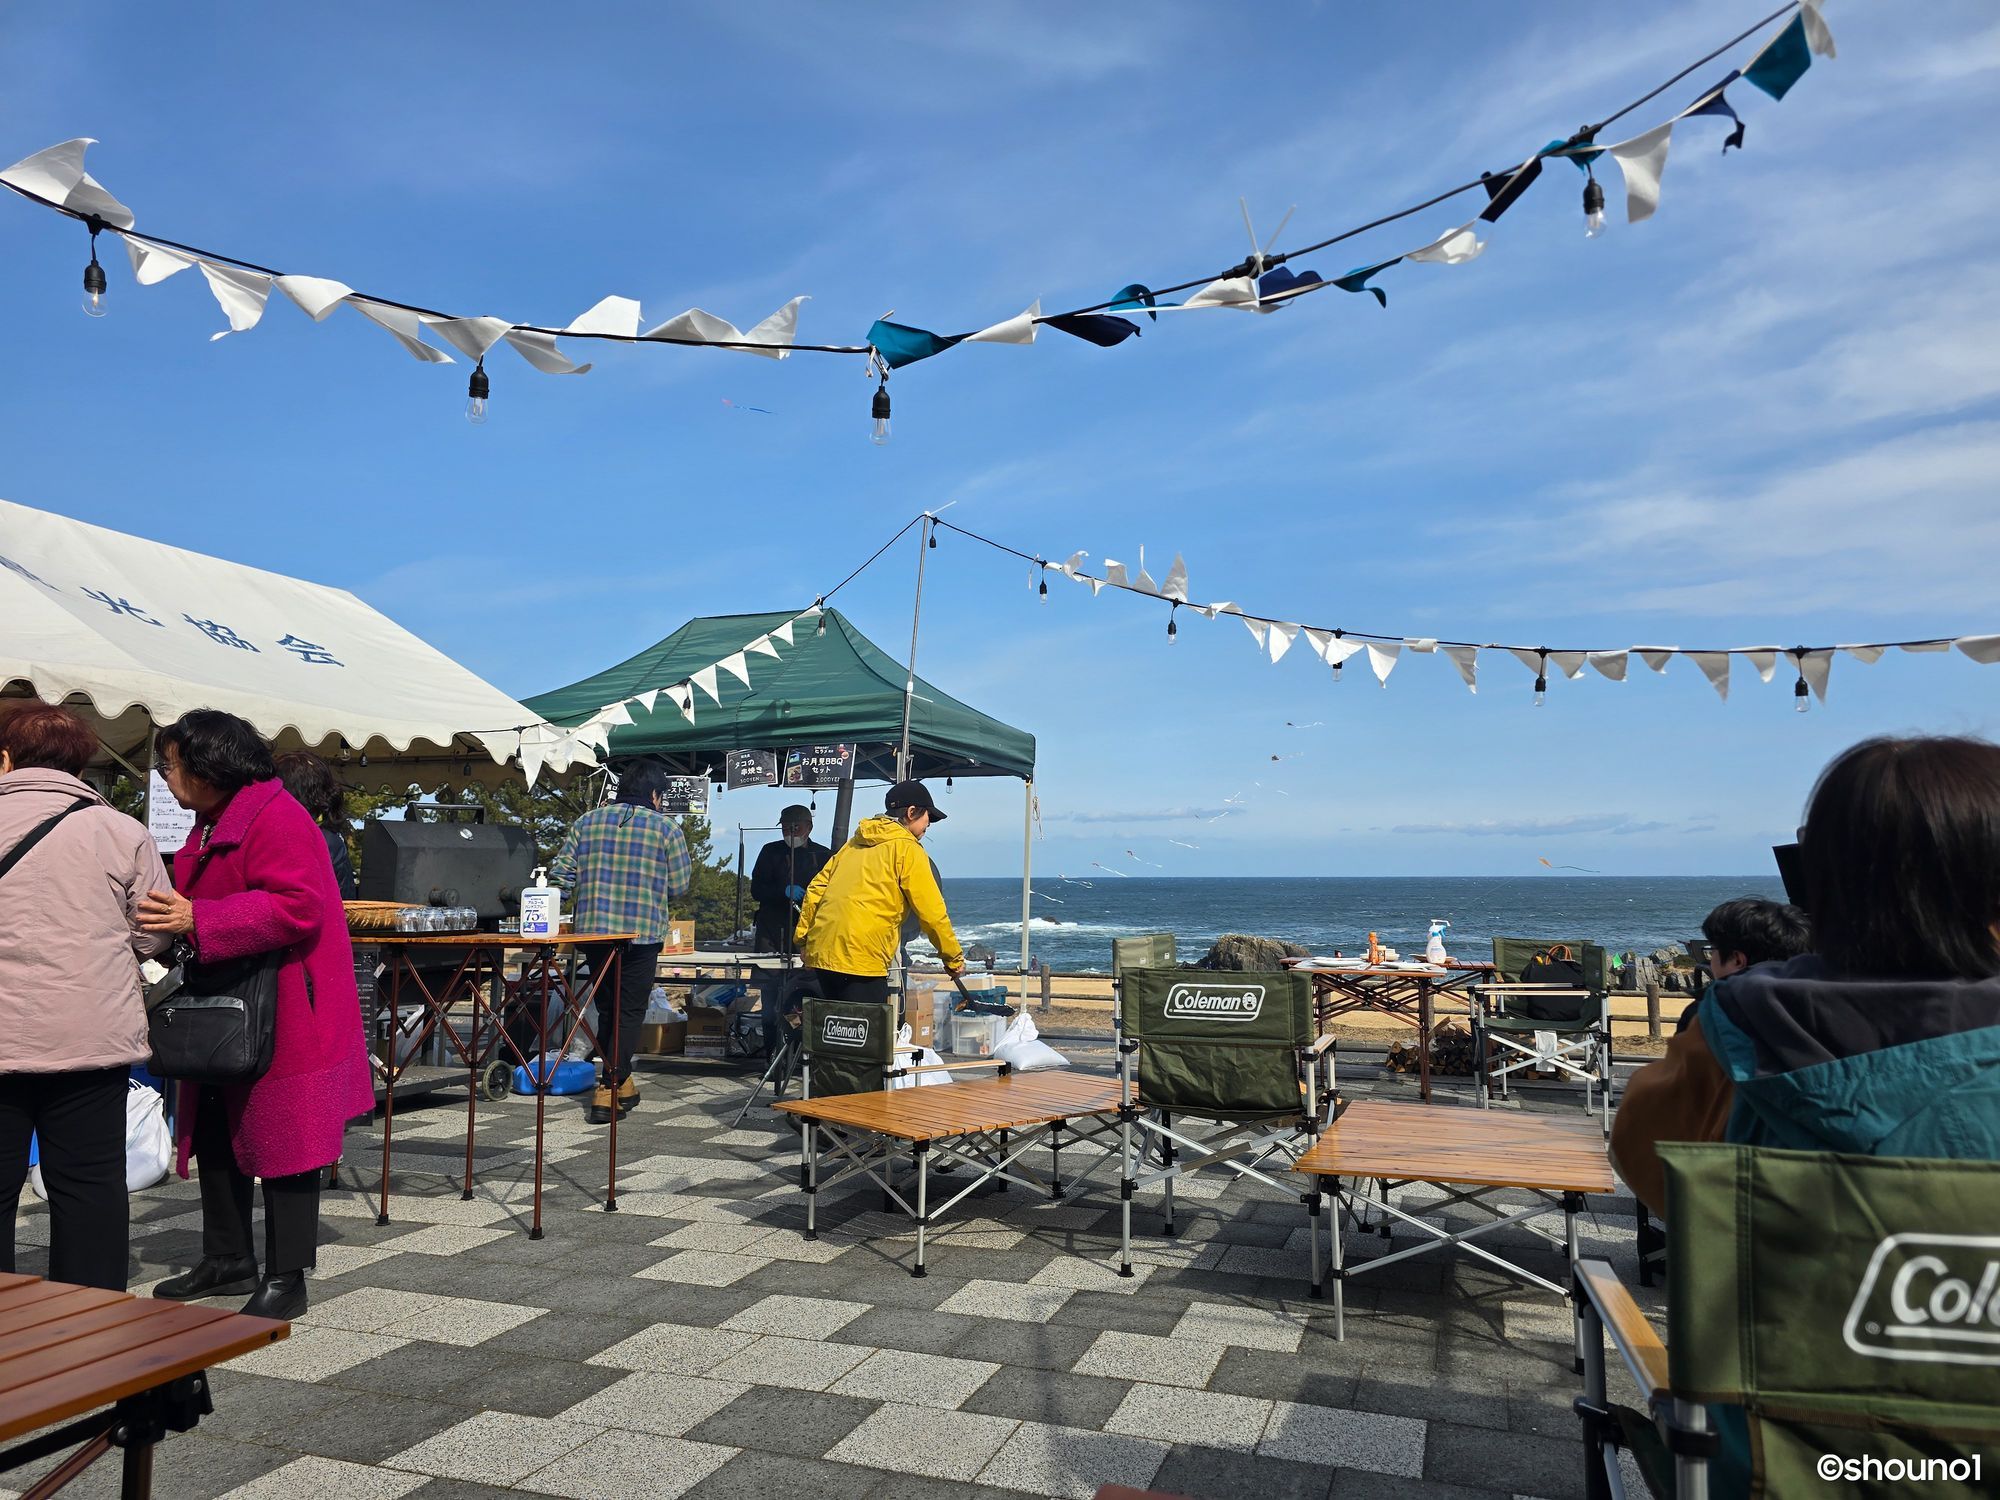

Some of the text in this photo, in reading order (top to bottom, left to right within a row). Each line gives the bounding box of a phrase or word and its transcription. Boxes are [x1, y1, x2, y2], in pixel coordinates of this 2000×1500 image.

[734, 759, 755, 769] タコの
[802, 757, 844, 766] お月見BBQ
[811, 766, 831, 774] セット
[525, 909, 547, 921] 75%
[1174, 989, 1241, 1011] Coleman
[826, 1020, 857, 1038] Coleman
